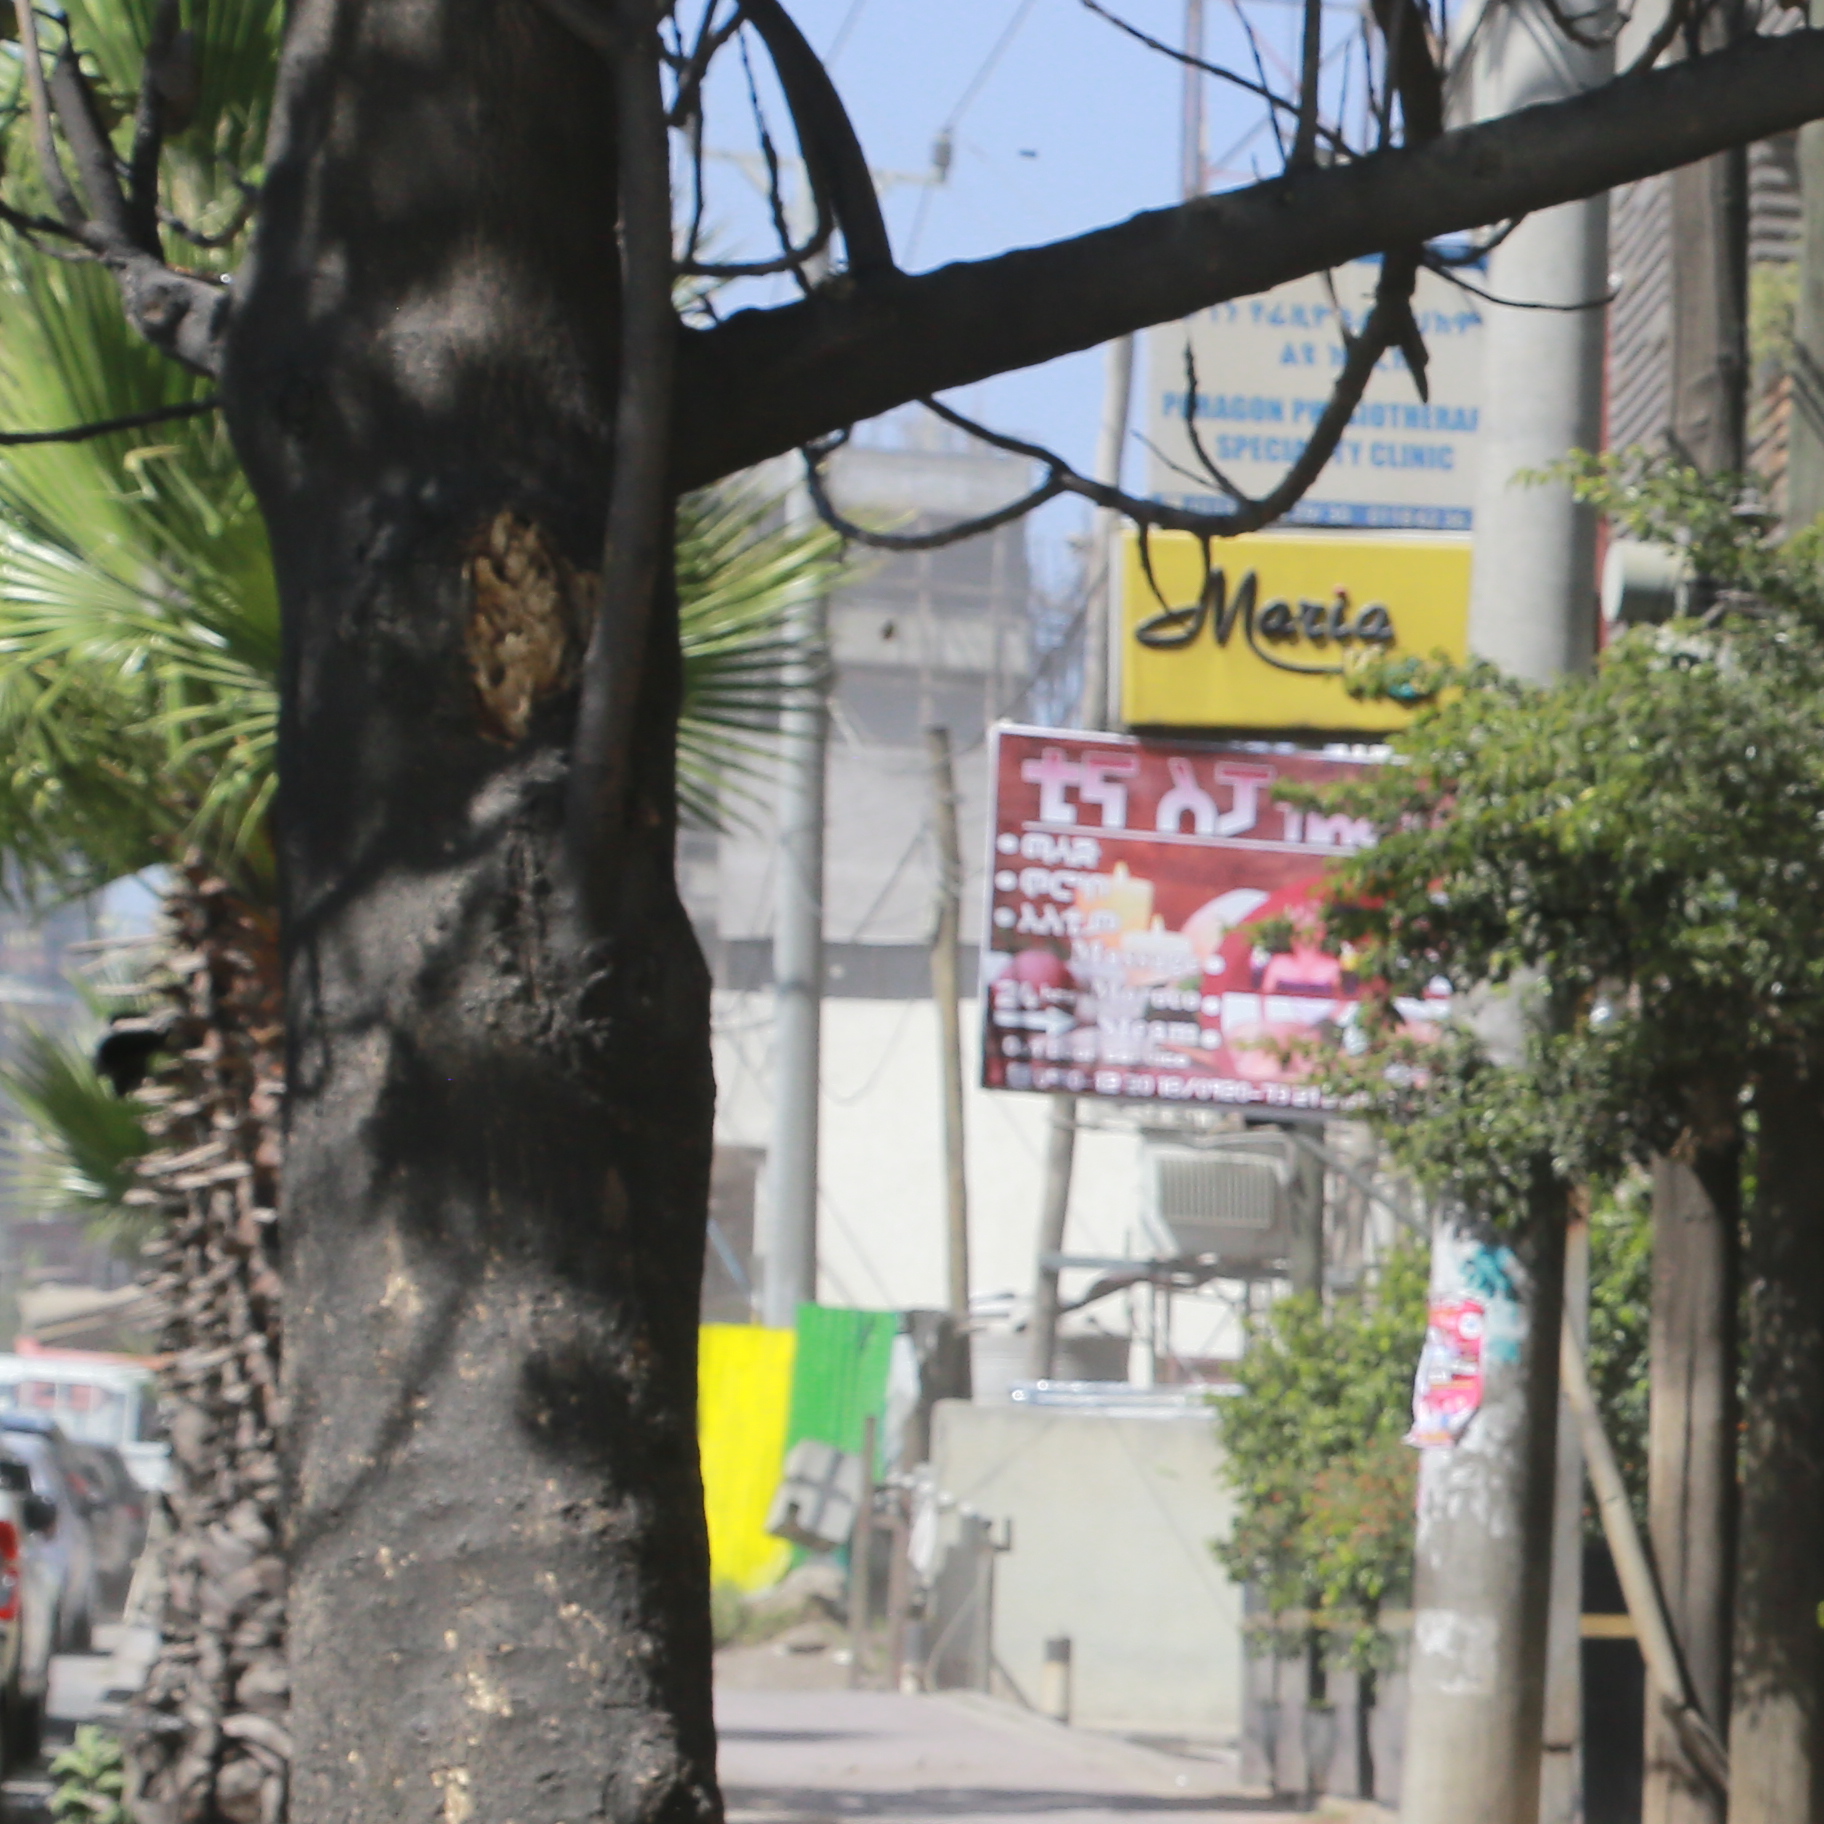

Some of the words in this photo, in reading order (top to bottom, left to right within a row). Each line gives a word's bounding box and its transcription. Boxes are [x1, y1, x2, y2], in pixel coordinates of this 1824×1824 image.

[1293, 397, 1479, 432] PHIOTHERA
[1370, 440, 1454, 471] CLINIC
[1136, 567, 1394, 673] Maria
